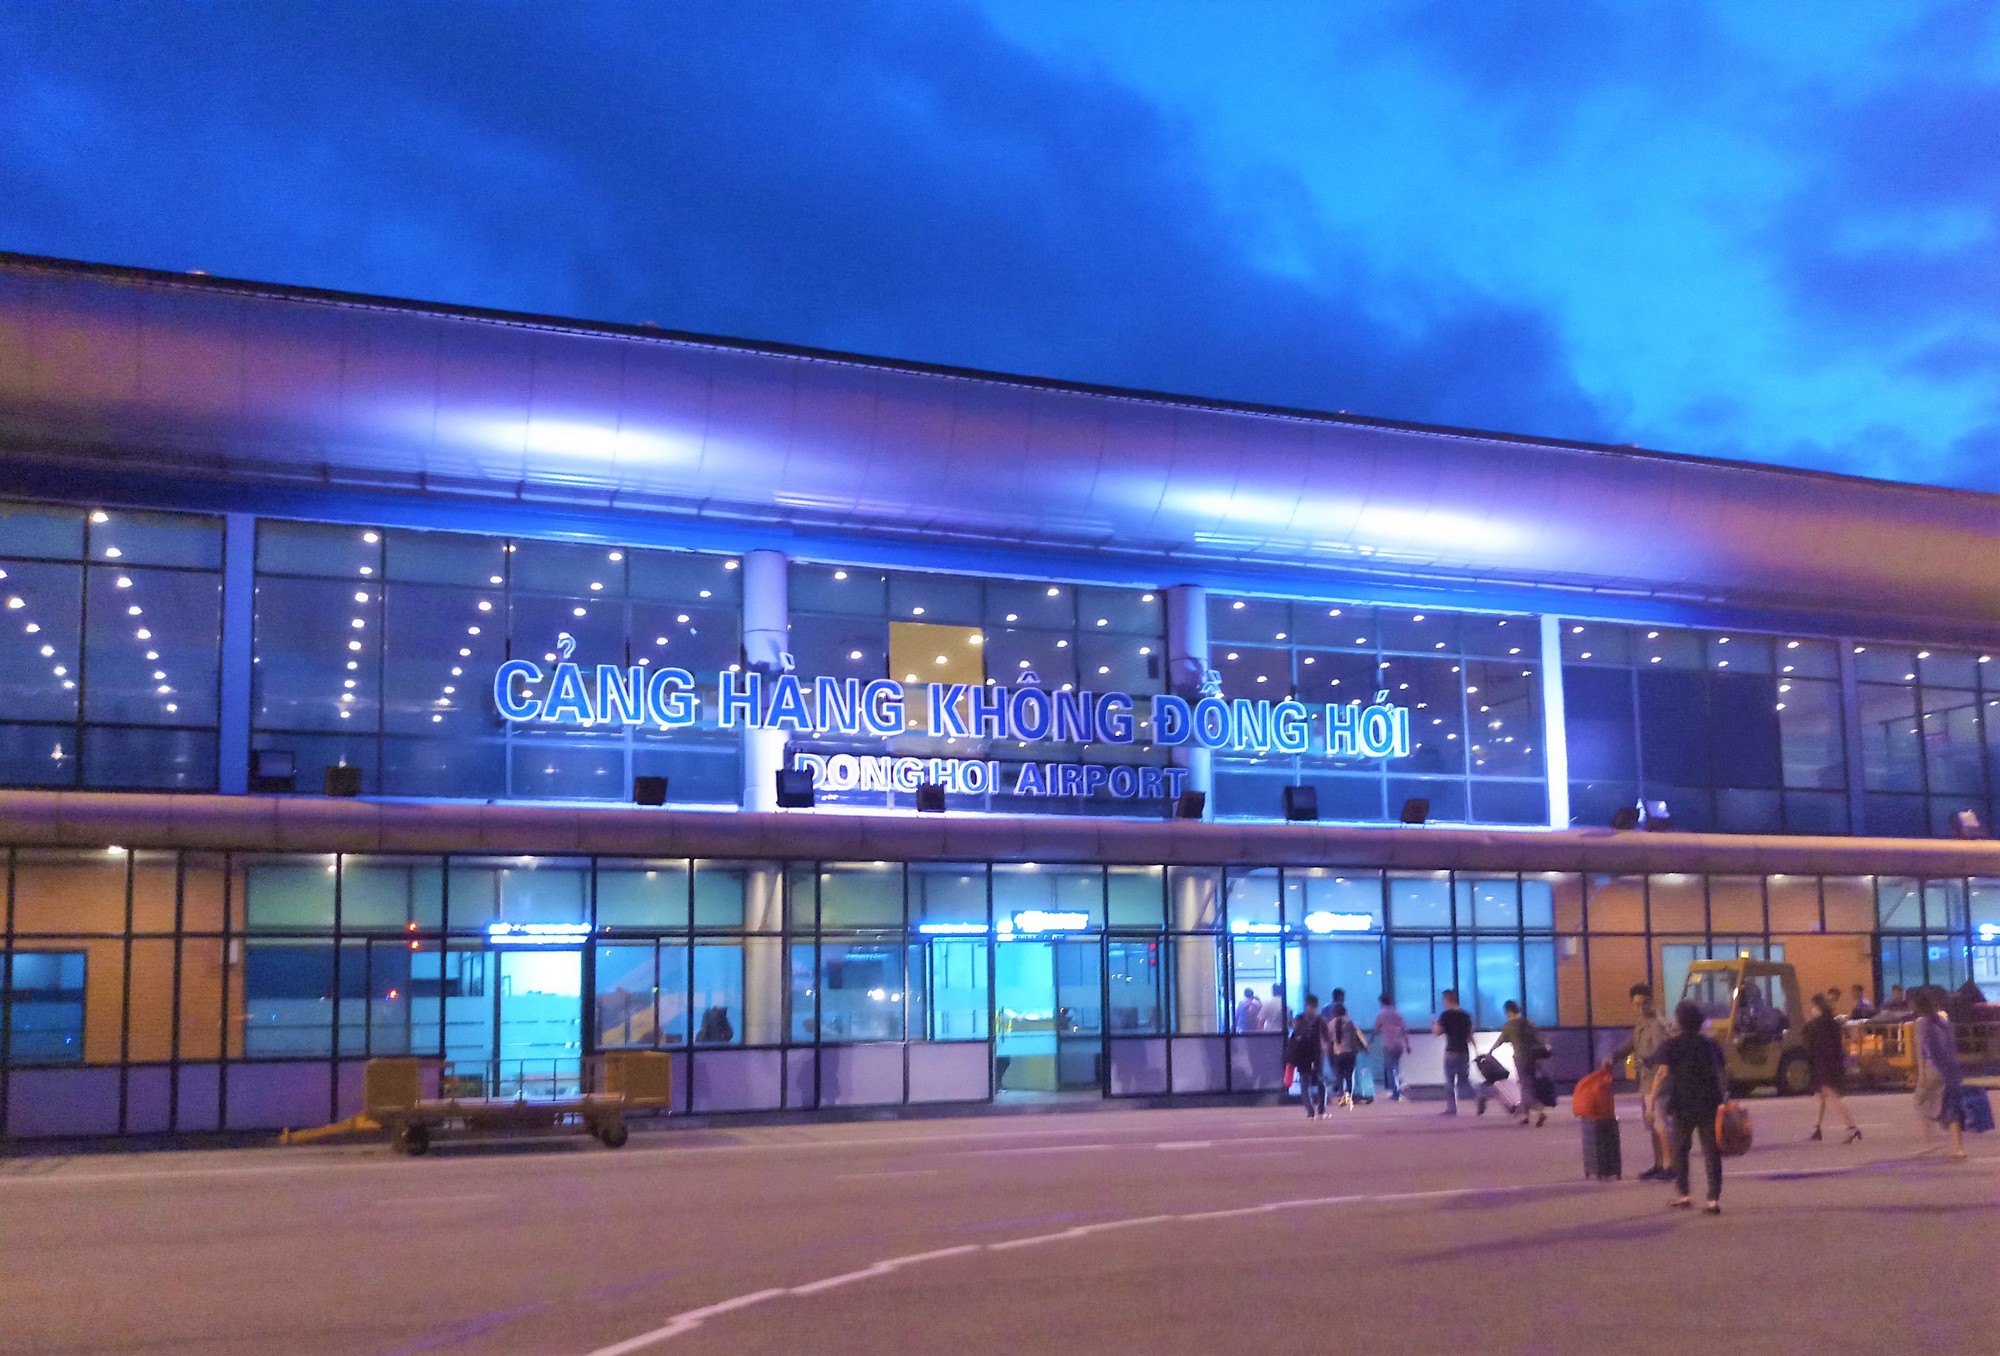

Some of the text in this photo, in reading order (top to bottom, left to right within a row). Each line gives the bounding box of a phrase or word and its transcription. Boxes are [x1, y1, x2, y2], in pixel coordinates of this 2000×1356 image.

[494, 635, 1410, 758] CẢNG HÀNG KHÔNG ĐỒNG HỚI
[1013, 762, 1188, 799] AIRPORT
